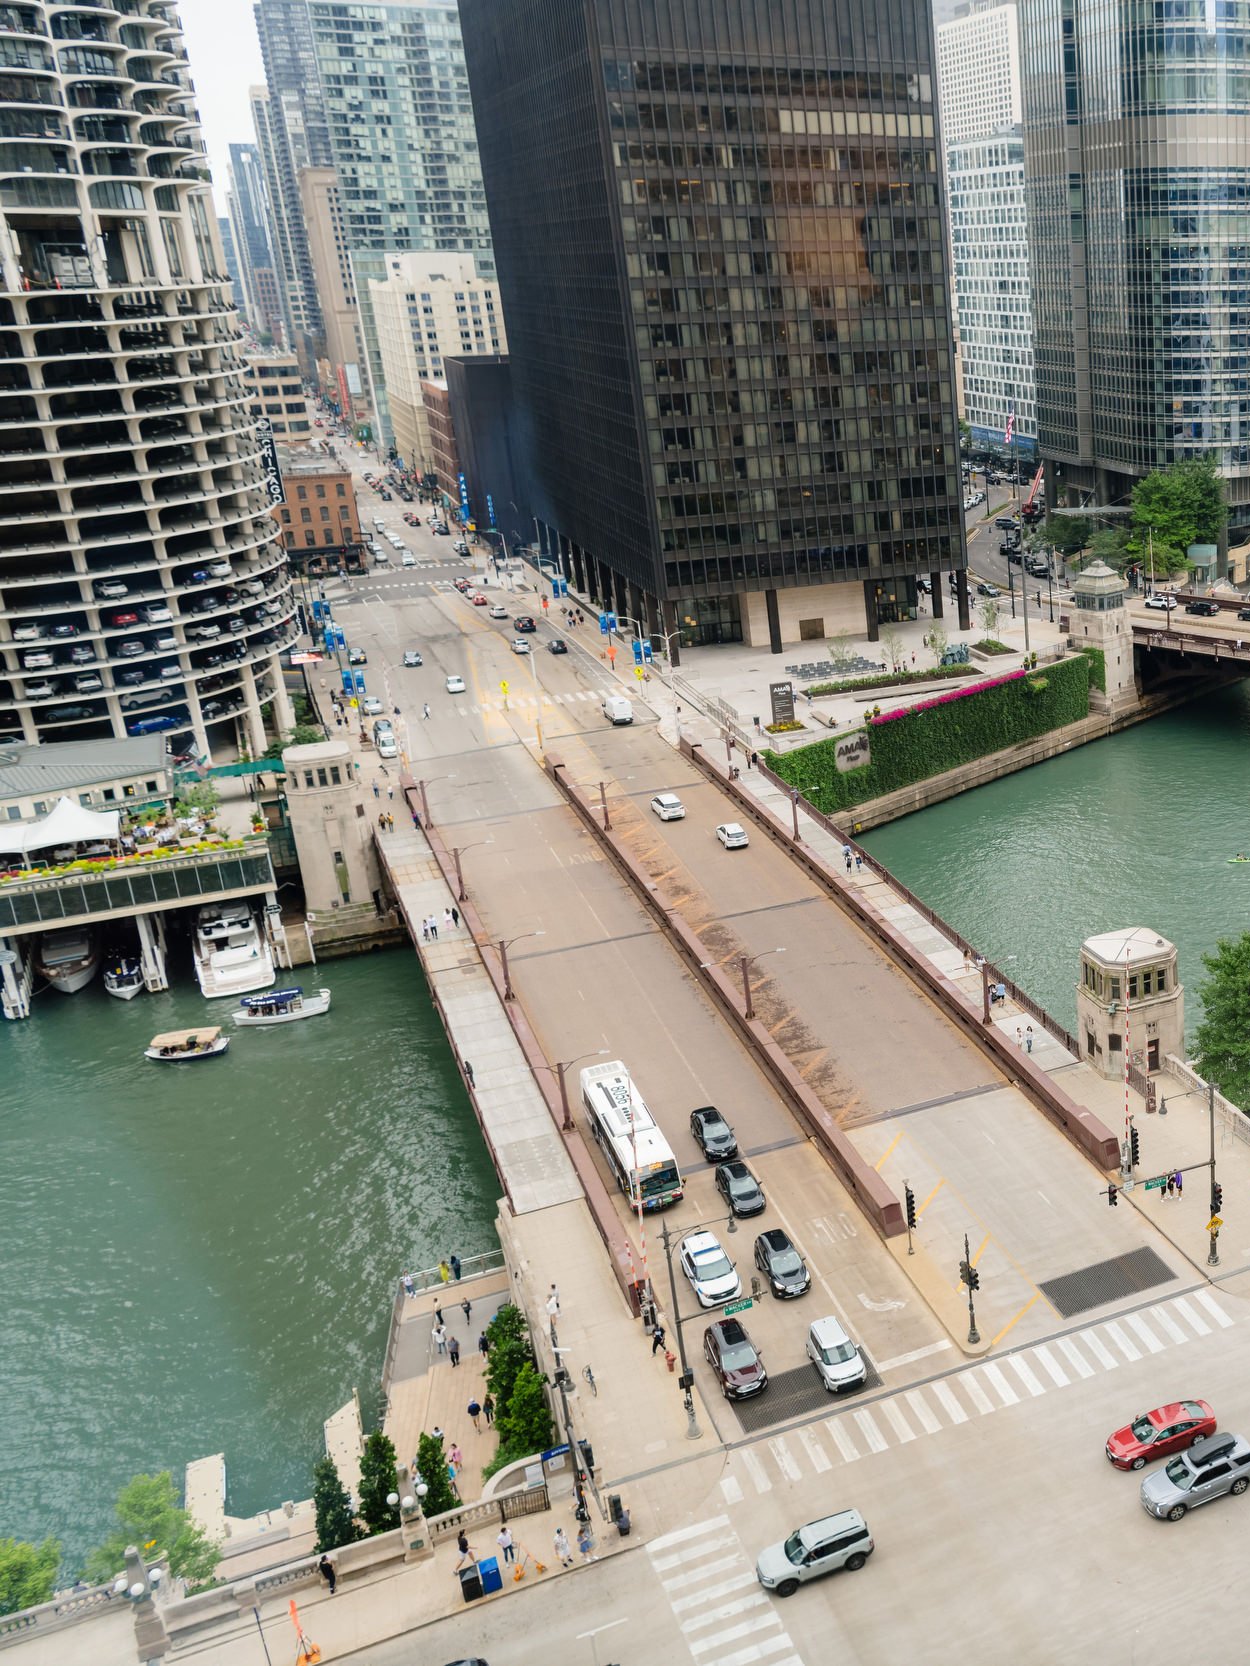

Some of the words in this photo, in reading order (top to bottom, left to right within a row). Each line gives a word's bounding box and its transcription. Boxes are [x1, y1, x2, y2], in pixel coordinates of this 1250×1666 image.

[261, 439, 283, 503] CHICAGO
[459, 476, 468, 505] PARK
[837, 741, 862, 758] AMA
